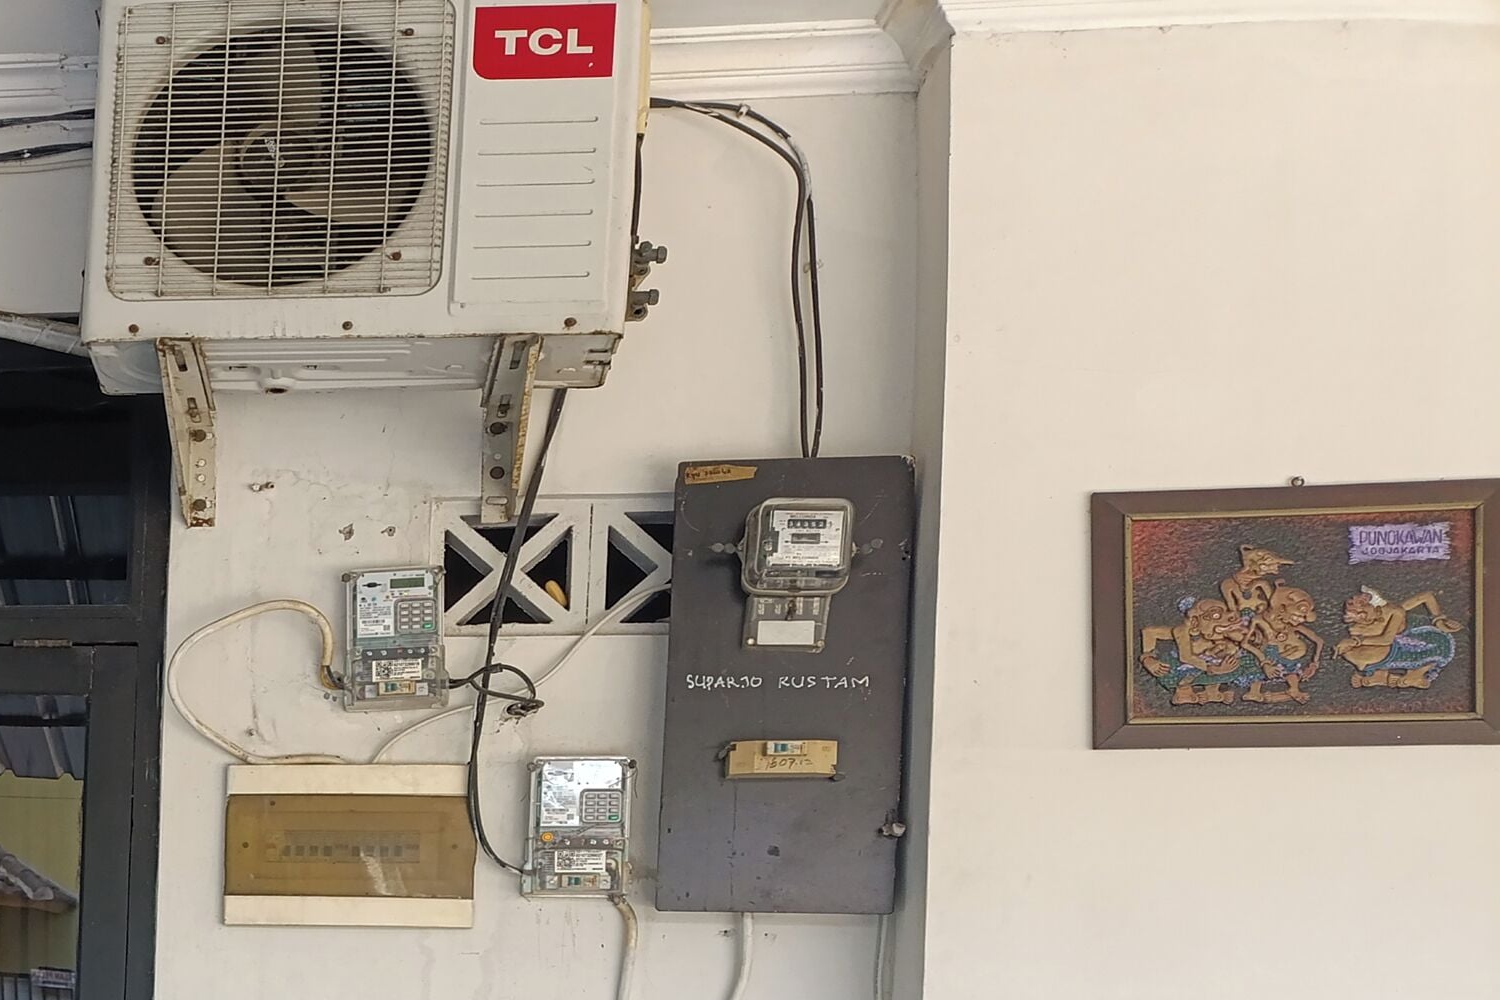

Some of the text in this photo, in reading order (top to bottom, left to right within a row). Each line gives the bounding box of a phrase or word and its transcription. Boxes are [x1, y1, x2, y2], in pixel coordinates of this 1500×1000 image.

[494, 27, 594, 56] TCL
[685, 674, 870, 691] SUPARJO RUSTAM
